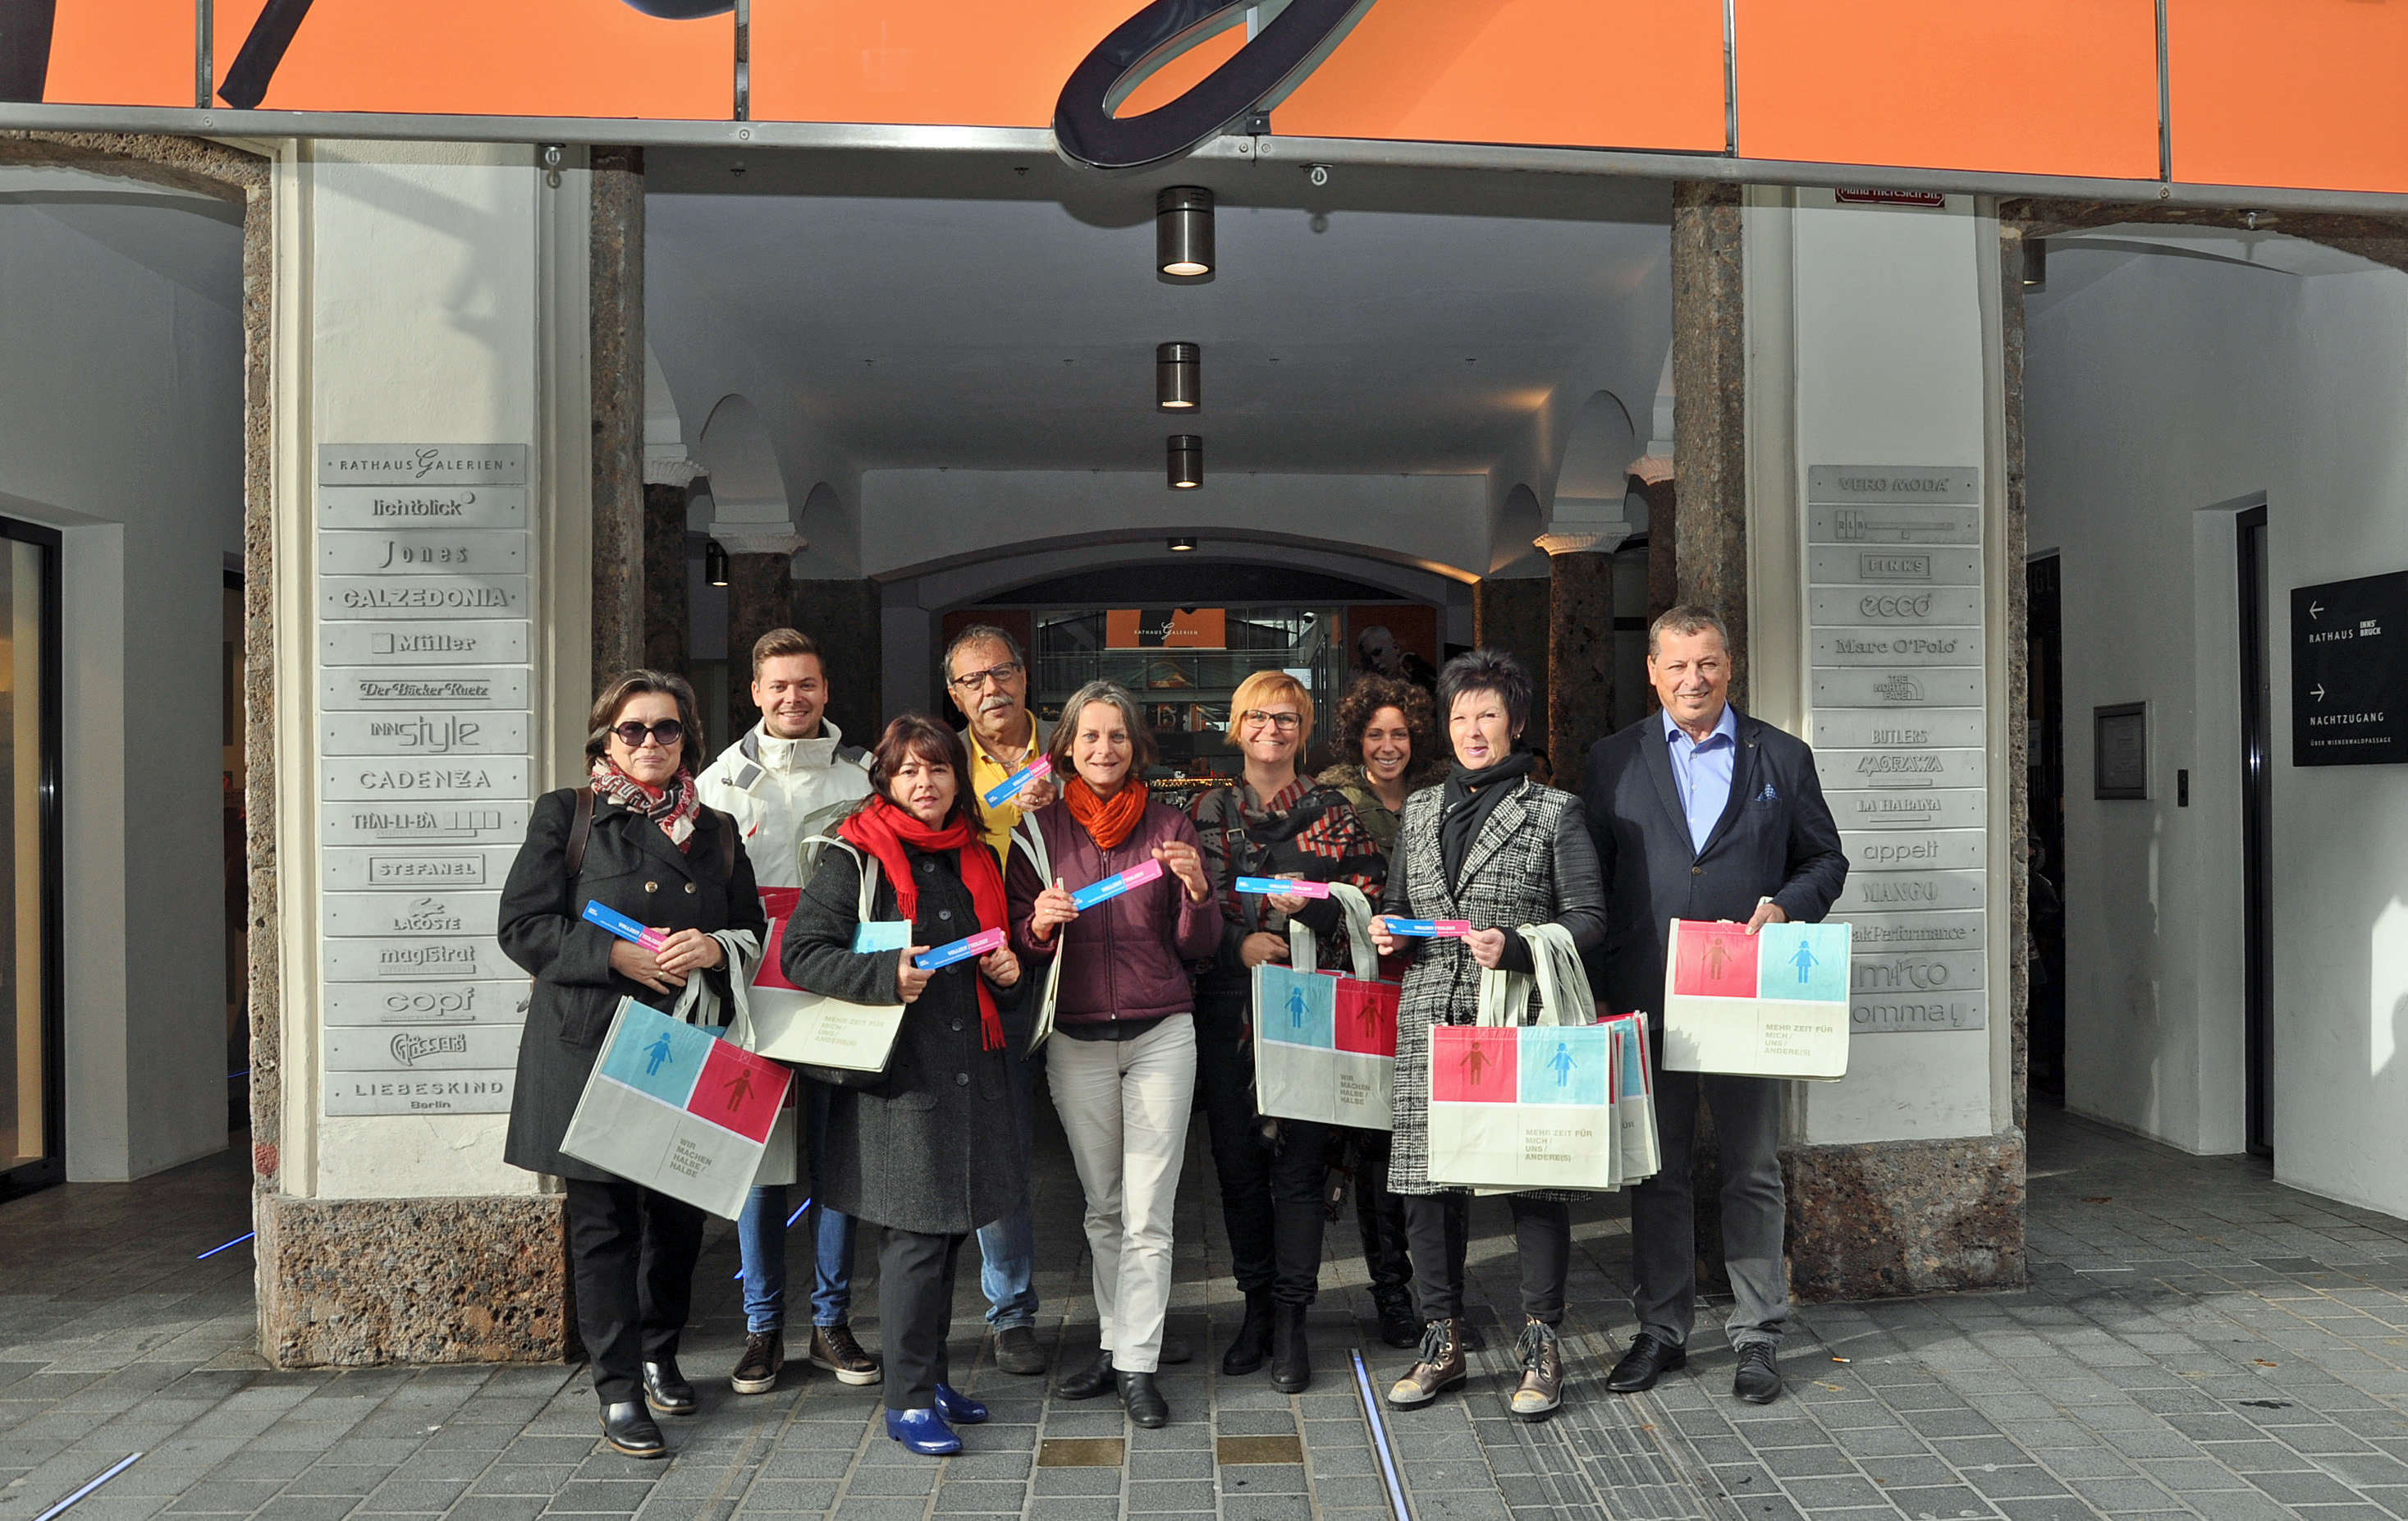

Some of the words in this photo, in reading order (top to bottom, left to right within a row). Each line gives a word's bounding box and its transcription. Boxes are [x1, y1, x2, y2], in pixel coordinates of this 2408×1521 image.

[340, 460, 413, 471] RATHAUS
[415, 448, 503, 479] GALERIEN
[1839, 478, 1887, 492] VERO
[372, 498, 464, 516] lichtblick
[378, 539, 469, 569] Jones
[341, 587, 509, 608] CALZEDONIA
[2309, 629, 2354, 644] RATHAUS
[2360, 626, 2382, 637] BRUCK
[397, 633, 477, 653] Müller
[1835, 639, 1888, 653] Marc
[1888, 675, 1908, 683] THE
[1874, 683, 1908, 692] NORTH
[1884, 692, 1908, 700] FACE
[2310, 712, 2385, 726] NACHTZUGANG
[1871, 729, 1928, 744] BUTLERS
[1856, 754, 1944, 777] MORAWA
[359, 769, 492, 790] CADENZA
[1856, 799, 1877, 813] LA
[1879, 799, 1942, 812] HABANA
[1862, 841, 1939, 863] appelt
[379, 863, 477, 876] STEFANEL
[1862, 882, 1939, 904] MANGO
[391, 917, 461, 931] LACOSTE
[379, 945, 476, 966] magistrat
[382, 986, 475, 1017] copf
[1765, 1024, 1792, 1032] MEHR
[1815, 1024, 1833, 1033] FÜR
[1764, 1047, 1811, 1056] ANDERE(S)
[1340, 1074, 1353, 1082] WIR
[355, 1081, 504, 1096] LIEBESKIND
[1340, 1082, 1371, 1091] MACHEN
[1340, 1089, 1364, 1097] HALBE
[410, 1100, 451, 1110] Berlin
[1340, 1097, 1364, 1105] HALBE
[1622, 1120, 1635, 1129] ÜR
[1526, 1129, 1552, 1137] MEHR
[1574, 1129, 1593, 1138] FÜR
[680, 1137, 697, 1150] WIR
[673, 1153, 701, 1171] HALBE
[675, 1146, 712, 1166] MACHEN
[1525, 1153, 1572, 1162] ANDERE(S)
[669, 1161, 698, 1179] HALBE
